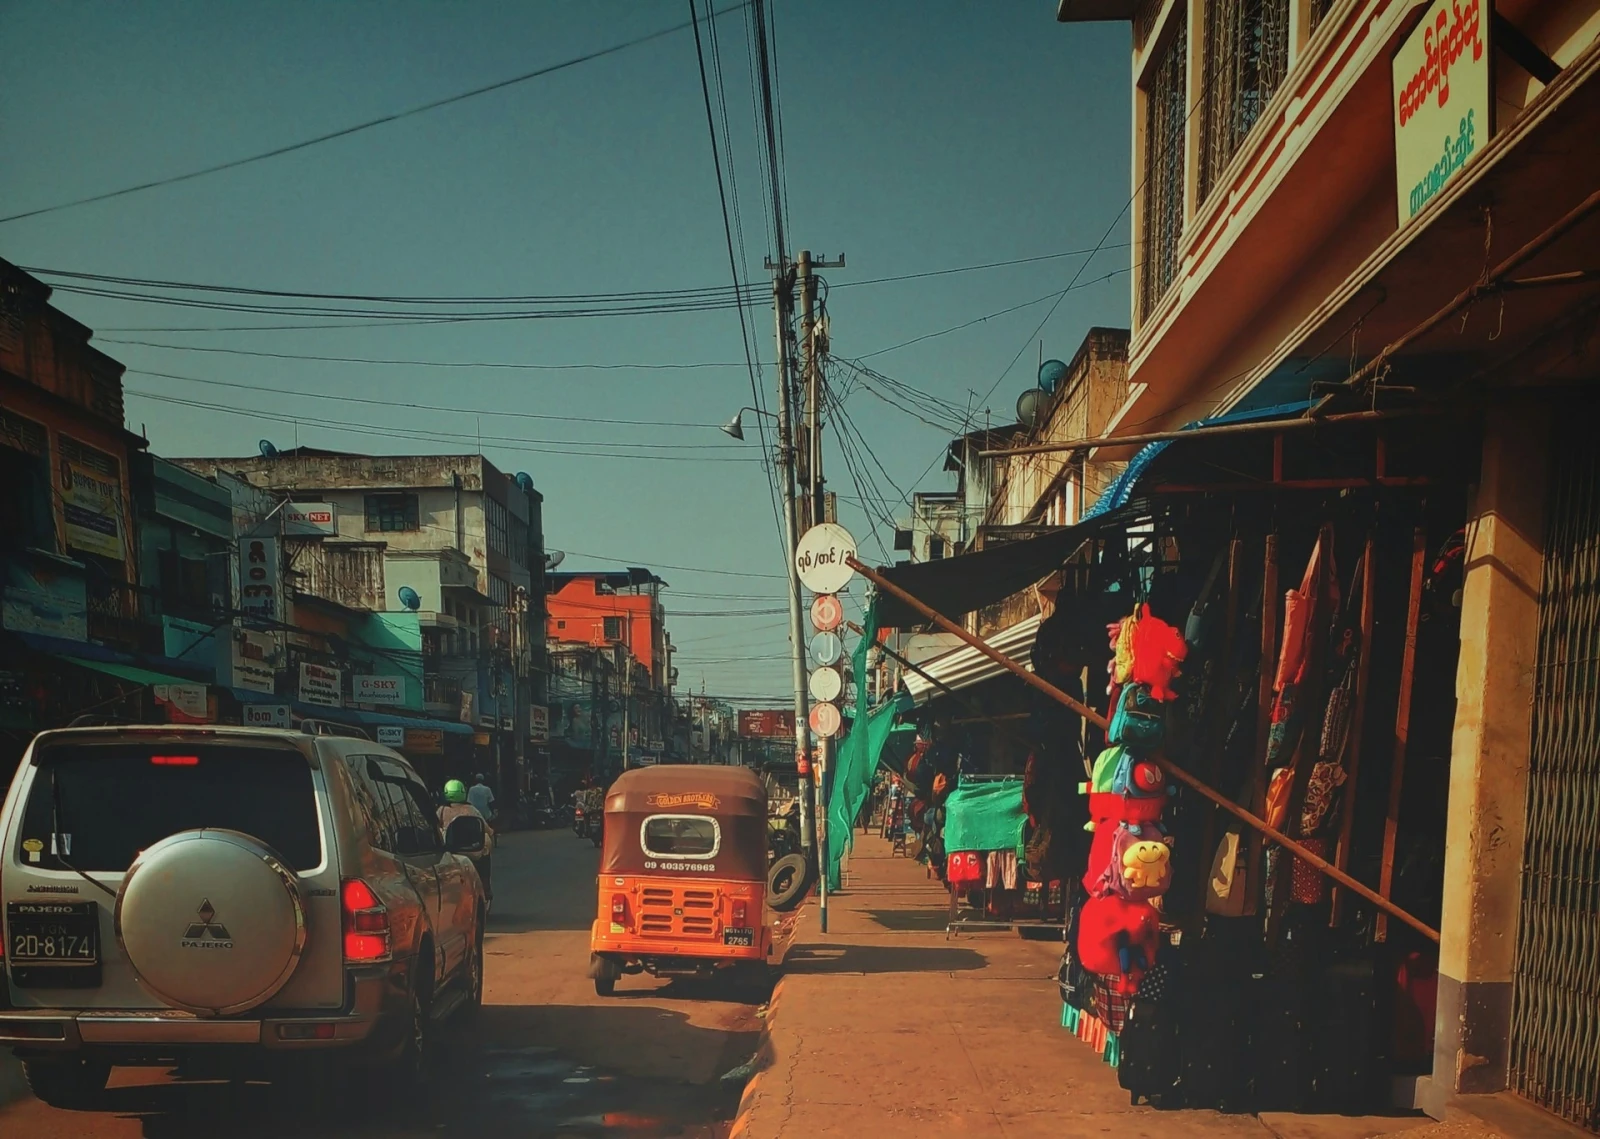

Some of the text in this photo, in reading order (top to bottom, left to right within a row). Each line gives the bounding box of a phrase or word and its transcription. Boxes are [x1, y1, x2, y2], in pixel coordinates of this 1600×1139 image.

[289, 514, 333, 522] SKY NET
[798, 550, 811, 573] ရပ်
[361, 680, 396, 689] G-SKY
[644, 861, 715, 872] 09 403576962
[19, 905, 73, 913] PAJERO
[39, 923, 67, 935] YGN
[15, 935, 90, 957] 2D-8174
[181, 941, 233, 949] PAJERO
